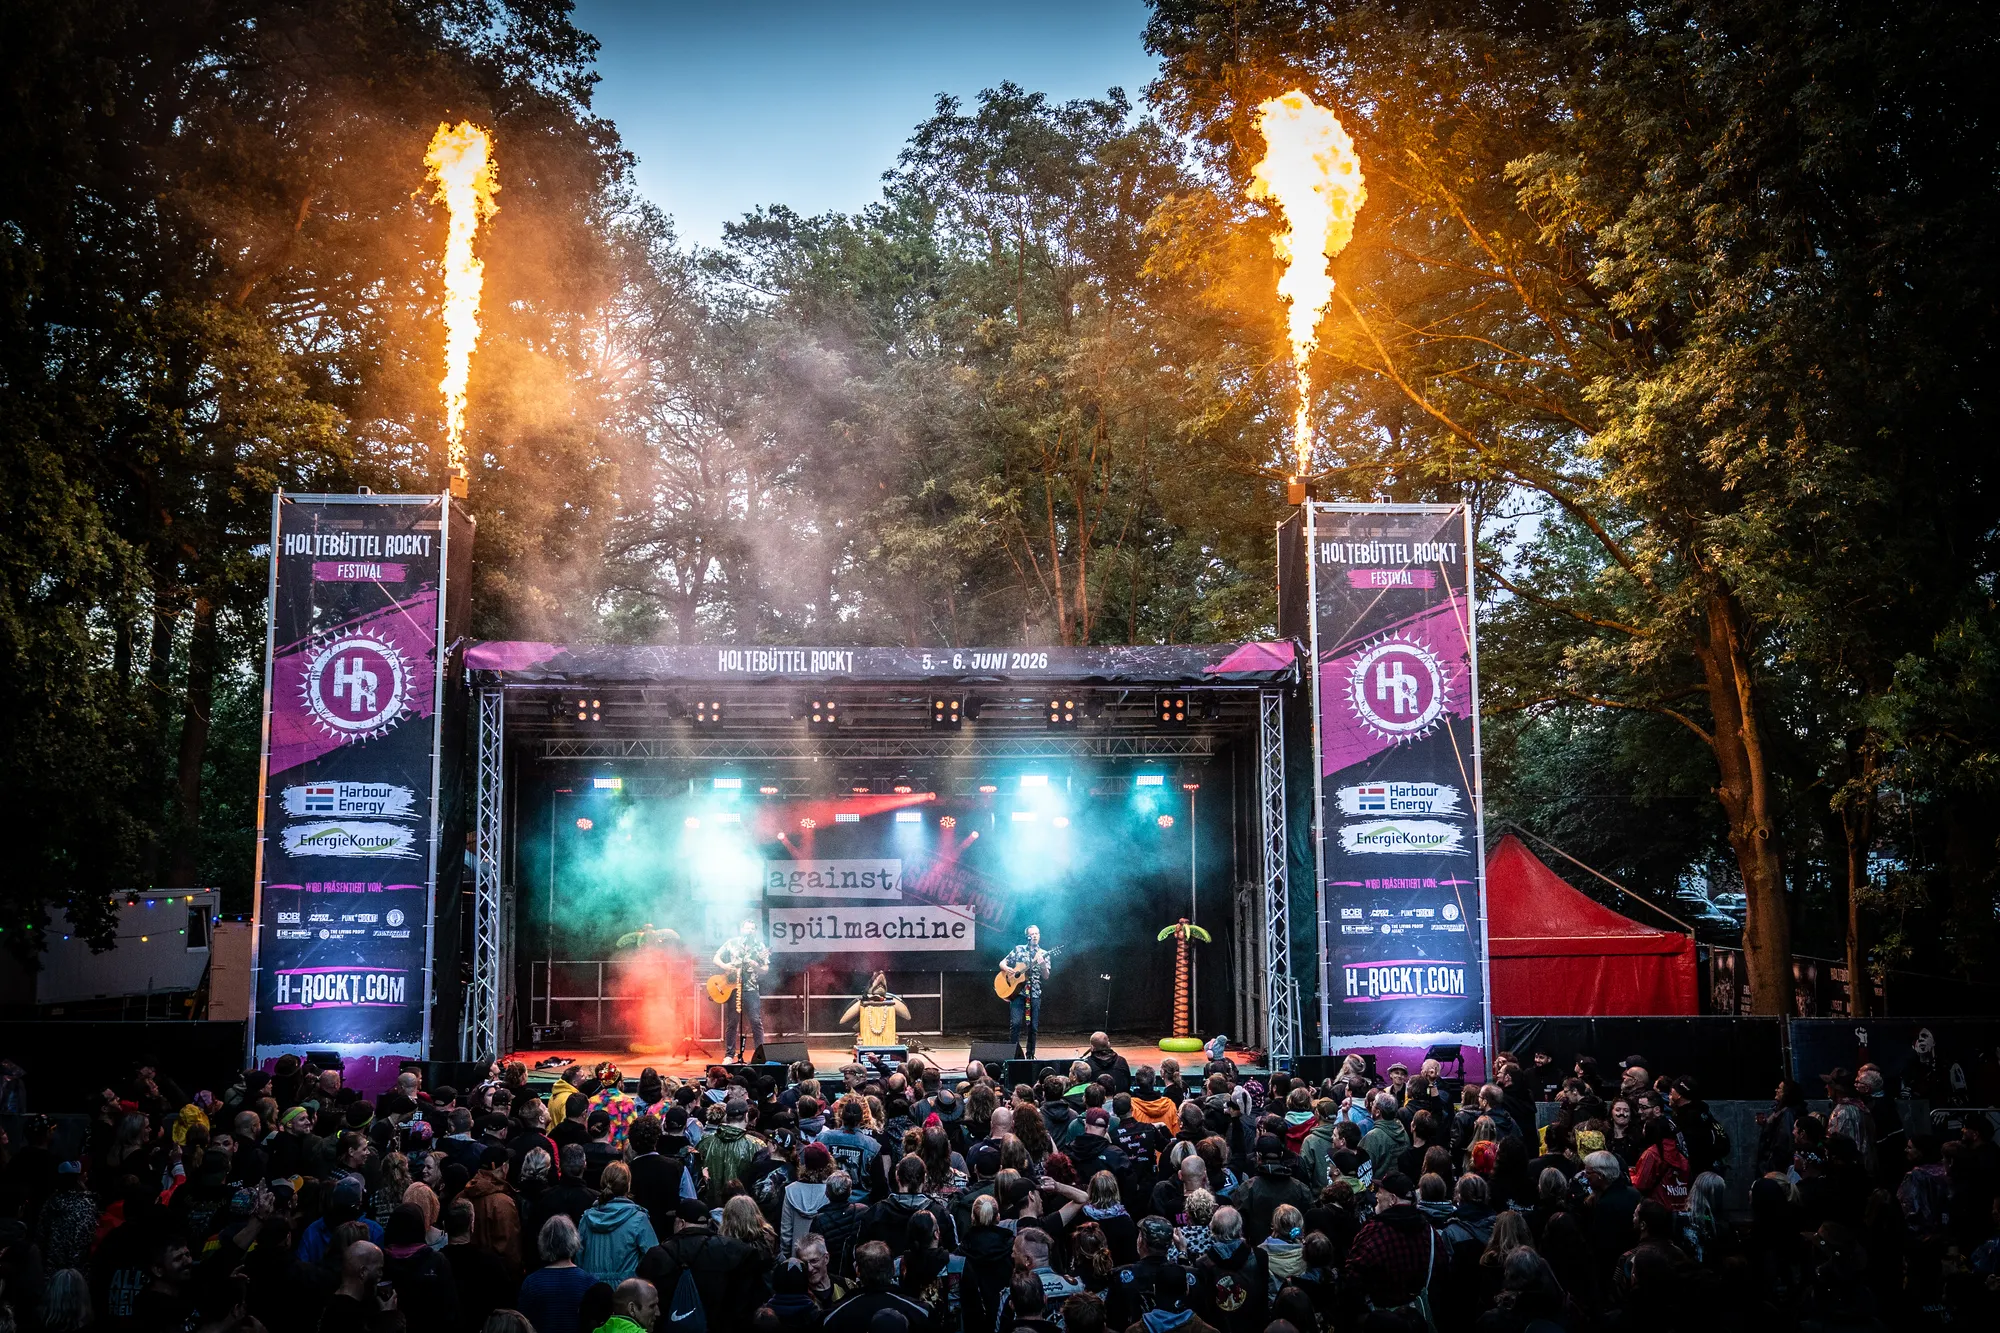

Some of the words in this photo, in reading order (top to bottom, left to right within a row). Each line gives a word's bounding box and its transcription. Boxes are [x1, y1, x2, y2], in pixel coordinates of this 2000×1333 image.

[285, 532, 381, 557] HOLTEBÜTTEL
[385, 534, 432, 557] ROCKT
[1321, 541, 1410, 564] HOLTEBÜTTEL
[1413, 542, 1457, 564] ROCKT
[338, 563, 382, 579] FESTIVAL
[1371, 571, 1413, 585] FESTIVAL
[718, 647, 808, 673] HOLTEBÜTTEL
[811, 651, 853, 673] ROCKT
[922, 654, 935, 670] 5.
[953, 653, 967, 670] 6.
[971, 653, 1008, 669] JUNI
[1012, 653, 1048, 669] 2026
[339, 785, 392, 798] Harbour
[1389, 785, 1439, 797] Harbour
[339, 799, 385, 815] Energy
[1390, 798, 1433, 813] Energy
[300, 834, 395, 849] EnergieKontor
[1356, 832, 1445, 847] EnergieKontor
[305, 882, 322, 893] WIRD
[323, 880, 366, 893] PRÄSENTIERT
[367, 882, 384, 893] VON:
[770, 866, 893, 893] against
[1365, 879, 1381, 889] WIRD
[1381, 877, 1422, 890] PRÄSENTIERT
[1423, 878, 1438, 889] VON:
[772, 915, 966, 945] spülmachine
[277, 974, 405, 1005] H-ROCKT.COM
[1346, 967, 1465, 998] H-ROCKT.COM
